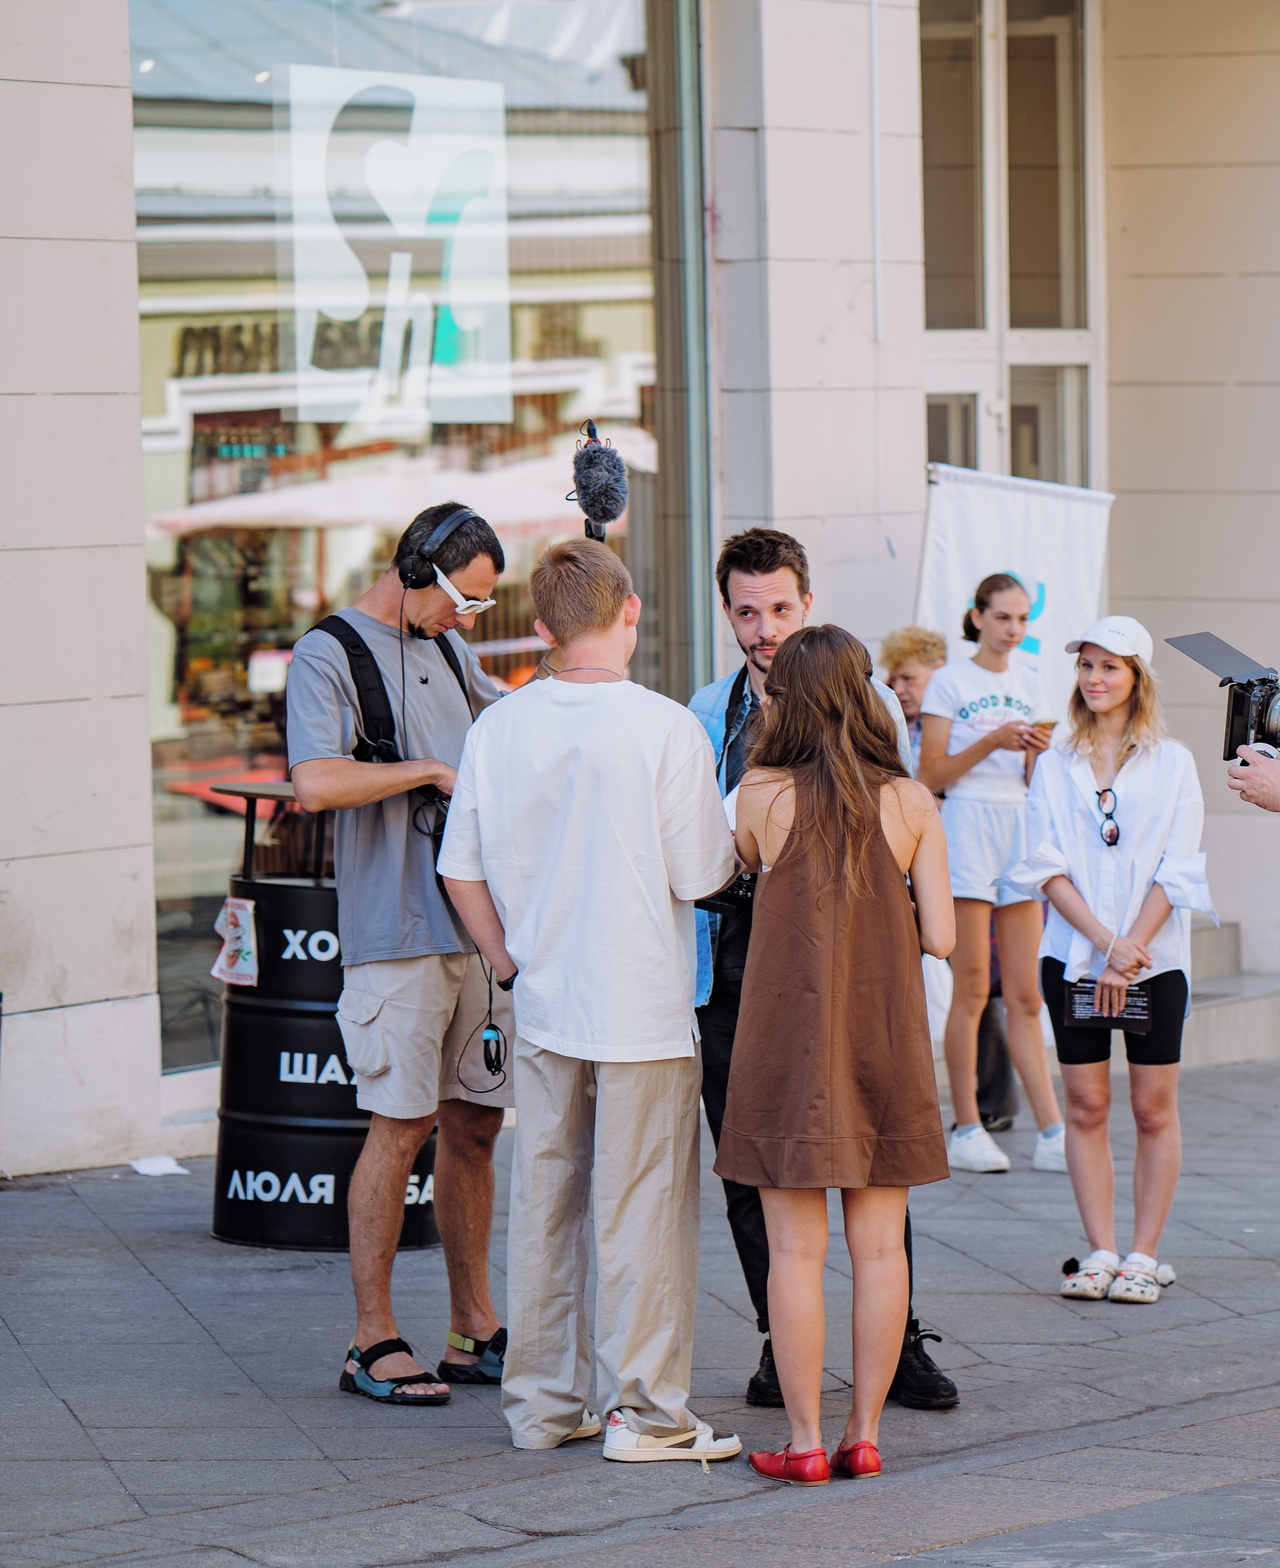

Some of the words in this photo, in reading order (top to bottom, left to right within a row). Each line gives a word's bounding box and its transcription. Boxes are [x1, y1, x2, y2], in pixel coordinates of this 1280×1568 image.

[281, 929, 339, 961] ХО
[279, 1052, 357, 1085] ША
[227, 1169, 335, 1204] ЛЮЛЯ
